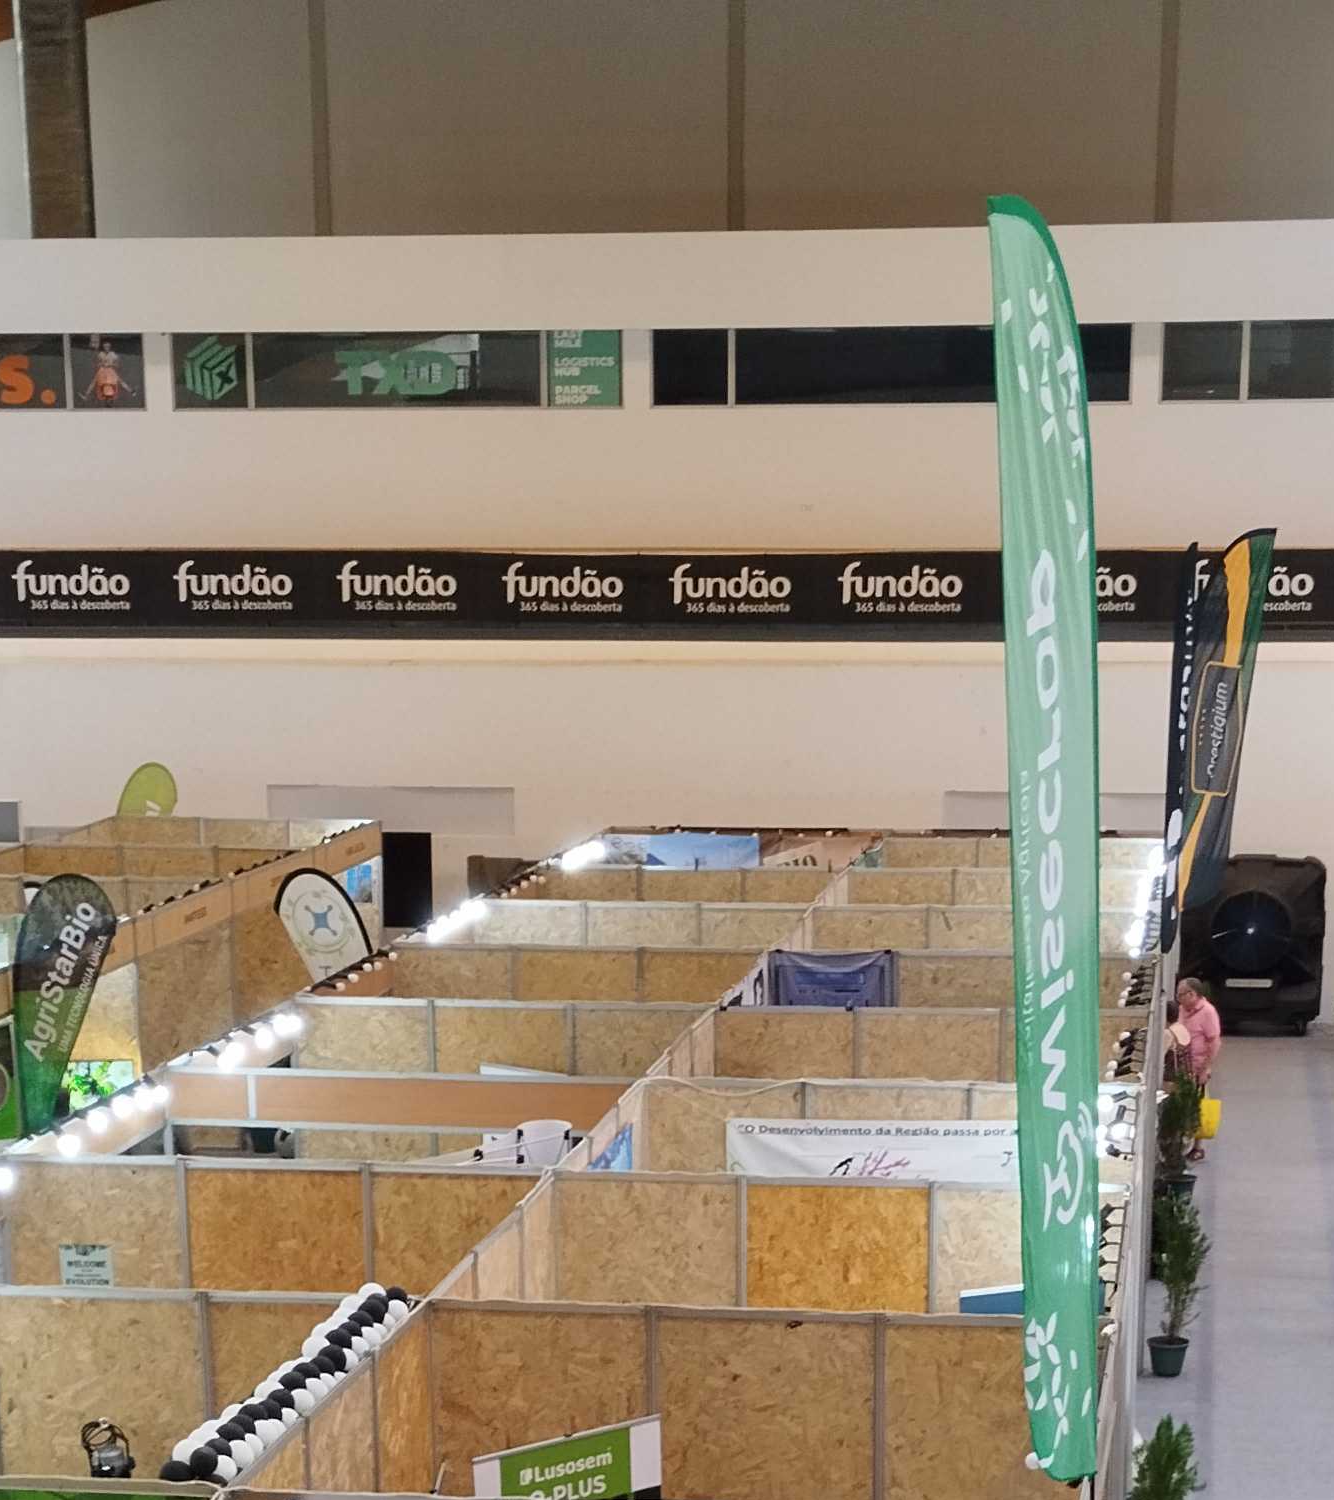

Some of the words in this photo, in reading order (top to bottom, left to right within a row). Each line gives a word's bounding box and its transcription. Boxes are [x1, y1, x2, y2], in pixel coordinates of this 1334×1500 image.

[555, 356, 615, 368] LOGISTICS
[12, 560, 131, 601] fundão
[174, 560, 293, 602] fundão
[336, 560, 458, 602] fundão
[502, 561, 623, 603] fundão
[668, 562, 791, 604] fundão
[837, 561, 963, 603] fundão
[686, 601, 704, 613] 365
[707, 601, 726, 614] dias
[738, 601, 791, 614] descoberta
[854, 601, 873, 613] 365
[876, 601, 896, 614] dias
[907, 601, 962, 614] descoberta
[23, 902, 96, 1064] AgriStarBio
[943, 1127, 979, 1139] passa
[982, 1126, 1009, 1138] por
[532, 1448, 612, 1484] Lusosem
